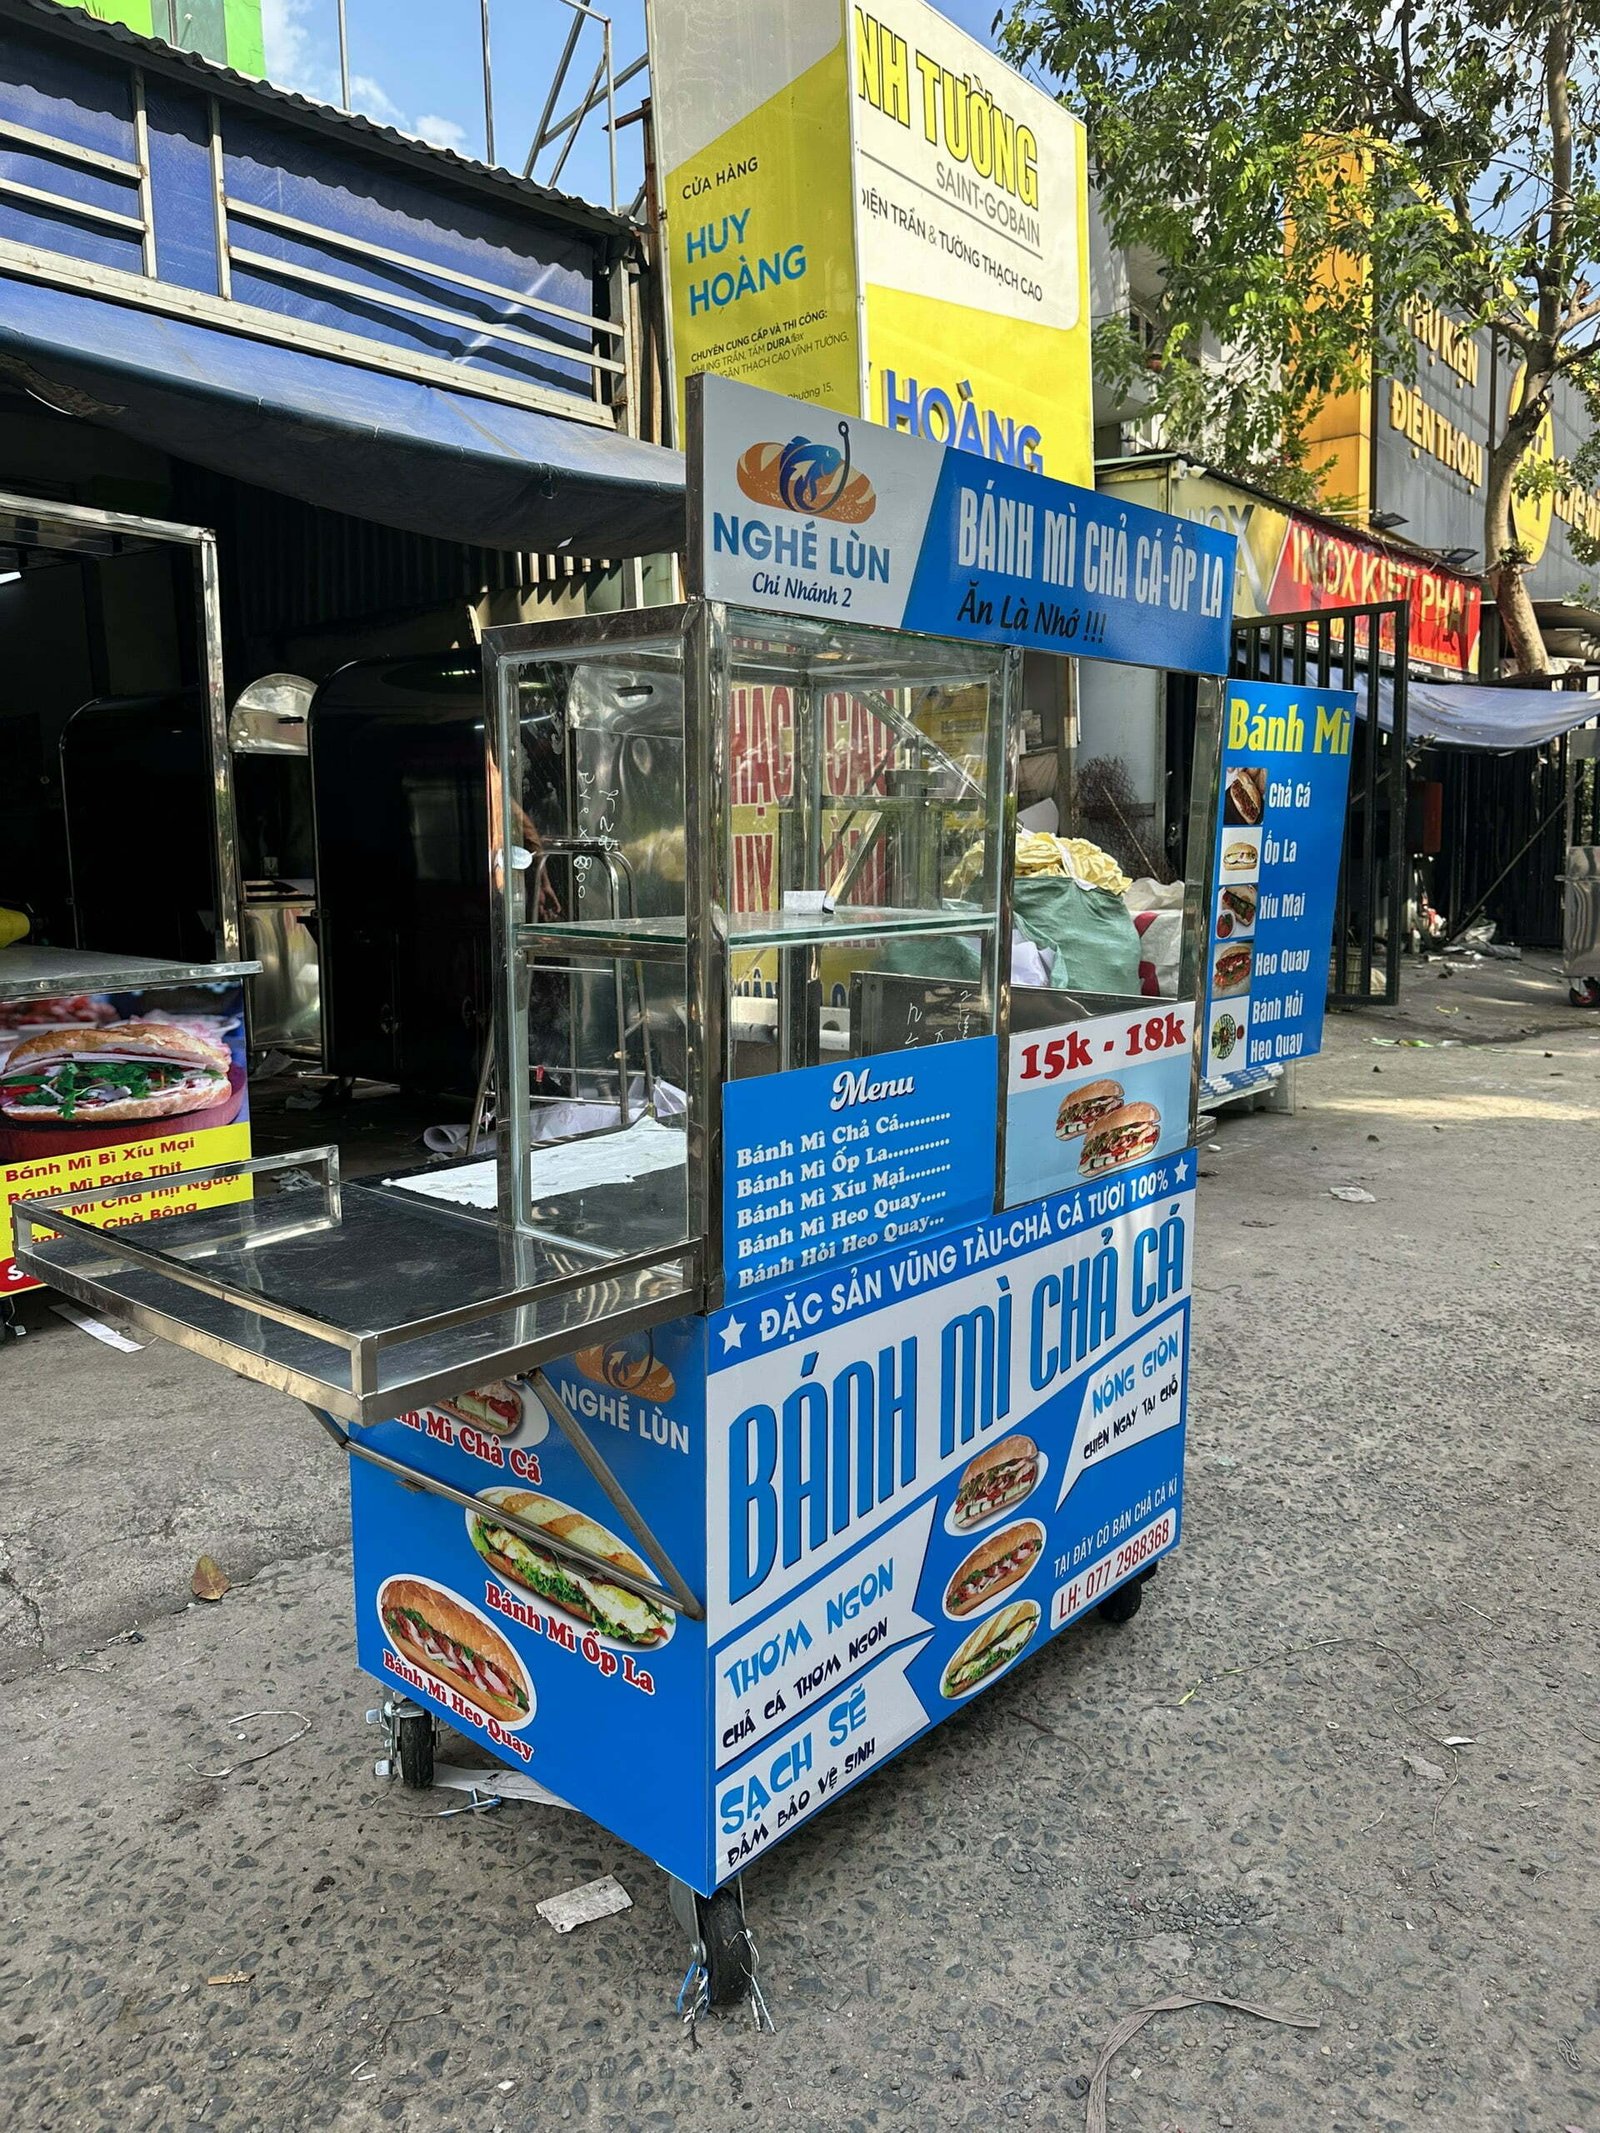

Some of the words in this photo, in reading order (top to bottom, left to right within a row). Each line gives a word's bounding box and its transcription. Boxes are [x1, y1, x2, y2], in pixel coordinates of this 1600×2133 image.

[915, 49, 1038, 211] TƯỜNG
[682, 176, 713, 201] CỬA
[716, 156, 759, 185] HÀNG
[936, 161, 1040, 247] SAINT-GOBAIN
[685, 208, 751, 264] HUY
[862, 188, 887, 219] IỆN
[891, 204, 926, 239] TRẦN
[928, 225, 937, 245] &
[939, 231, 980, 267] TƯỜNG
[982, 254, 1018, 290] THẠCH
[1021, 277, 1043, 302] CAO
[689, 245, 807, 316] HOÀNG
[691, 343, 725, 362] CHUYÊN
[726, 336, 751, 351] CUNG
[751, 326, 768, 342] CẤP
[769, 322, 783, 336] VÀ
[783, 319, 797, 332] THI
[799, 310, 828, 326] CÔNG:
[742, 357, 770, 374] THẠCH
[771, 350, 791, 364] CAO
[880, 369, 1043, 476] HOÀNG
[1390, 379, 1434, 458] ĐIỆN
[1437, 418, 1483, 495] THOẠI
[713, 511, 818, 572] NGHÉ
[829, 530, 891, 584] LÙN
[958, 478, 1034, 578] BÁNH
[1042, 503, 1076, 589] MÌ
[1082, 514, 1128, 599] CHẢ
[1134, 522, 1197, 612] CÁ-ỐP
[1201, 553, 1223, 618] LA
[752, 571, 778, 597] Chi
[784, 576, 840, 605] Nhánh
[840, 586, 852, 607] 2
[957, 580, 994, 625] Ăn
[1002, 598, 1029, 630] Là
[1035, 601, 1080, 637] Nhớ
[1086, 610, 1106, 643] !!!
[1227, 698, 1304, 753] Bánh
[1313, 705, 1350, 755] Mì
[1268, 778, 1292, 808] Chả
[1295, 782, 1311, 808] Cá
[1264, 830, 1280, 866] Ốp
[1283, 838, 1297, 862] La
[1259, 893, 1278, 920] Xíu
[1282, 893, 1306, 922] Mại
[1255, 952, 1277, 977] Heo
[1281, 949, 1310, 975] Quay
[1252, 997, 1281, 1025] Bánh
[1284, 990, 1304, 1018] Hỏi
[1020, 1030, 1093, 1080] 15k
[1125, 1012, 1187, 1056] 18k
[1250, 1038, 1272, 1063] Heo
[1275, 1032, 1303, 1058] Quay
[829, 1068, 915, 1112] Menu
[5, 1162, 61, 1182] Bánh
[68, 1154, 92, 1171] Mì
[98, 1149, 116, 1166] Bì
[123, 1144, 154, 1161] Xíu
[160, 1137, 195, 1154] Mại
[736, 1140, 794, 1169] Bánh
[801, 1131, 826, 1153] Mì
[832, 1120, 870, 1145] Chả
[736, 1170, 794, 1199] Bánh
[801, 1160, 826, 1183] Mì
[831, 1149, 860, 1173] Ốp
[100, 1171, 143, 1187] Pate
[150, 1202, 198, 1220] Bông
[736, 1199, 794, 1229] Bánh
[801, 1189, 826, 1211] Mì
[831, 1178, 867, 1203] Xíu
[737, 1228, 794, 1259] Bánh
[801, 1218, 826, 1241] Mì
[832, 1207, 869, 1231] Heo
[738, 1258, 795, 1289] Bánh
[801, 1242, 836, 1268] Hỏi
[841, 1232, 879, 1256] Heo
[759, 1294, 823, 1343] ĐẶC
[831, 1266, 883, 1316] SẢN
[888, 1249, 957, 1293] VŨNG
[962, 1201, 1052, 1263] TÀU-CHẢ
[1057, 1192, 1084, 1231] CÁ
[1088, 1184, 1125, 1220] TƯƠI
[1130, 1168, 1169, 1202] 100%
[728, 1335, 918, 1606] BÁNH
[939, 1274, 1012, 1460] MÌ
[1029, 1225, 1119, 1392] CHẢ
[1132, 1203, 1186, 1318] CÁ
[1092, 1364, 1135, 1418] NÓNG
[1142, 1330, 1178, 1378] GIÒN
[427, 1411, 453, 1444] Mì
[459, 1426, 504, 1466] Chả
[510, 1449, 541, 1483] Cá
[561, 1379, 630, 1432] NGHÉ
[639, 1405, 689, 1455] LÙN
[1083, 1426, 1110, 1460] CHIÊN
[1113, 1406, 1138, 1438] NGAY
[1141, 1395, 1156, 1416] TẠI
[1159, 1373, 1178, 1402] CHỖ
[1054, 1551, 1070, 1579] TẠI
[1073, 1535, 1093, 1565] ĐÂY
[1096, 1521, 1110, 1549] CÓ
[1112, 1508, 1132, 1538] BÁN
[1134, 1489, 1152, 1522] CHẢ
[1154, 1482, 1166, 1508] CÁ
[1059, 1583, 1081, 1620] LH:
[1086, 1560, 1111, 1599] 077
[1115, 1518, 1170, 1579] 2988368
[485, 1581, 543, 1632] Bánh
[547, 1615, 576, 1652] Mì
[582, 1628, 617, 1674] Ốp
[623, 1656, 655, 1694] La
[723, 1618, 814, 1700] THƠM
[826, 1557, 895, 1636] NGON
[383, 1649, 423, 1689] Bánh
[426, 1678, 448, 1706] Mì
[450, 1695, 484, 1728] Heo
[487, 1718, 534, 1762] Quay
[723, 1710, 757, 1749] CHẢ
[763, 1690, 787, 1721] CÁ
[793, 1654, 842, 1701] THƠM
[848, 1616, 889, 1663] NGON
[720, 1731, 813, 1835] SẠCH
[828, 1682, 868, 1749] SẼ
[727, 1820, 769, 1868] ĐẢM
[777, 1789, 810, 1829] BẢO
[817, 1767, 839, 1795] VỆ
[844, 1737, 876, 1774] SINH
